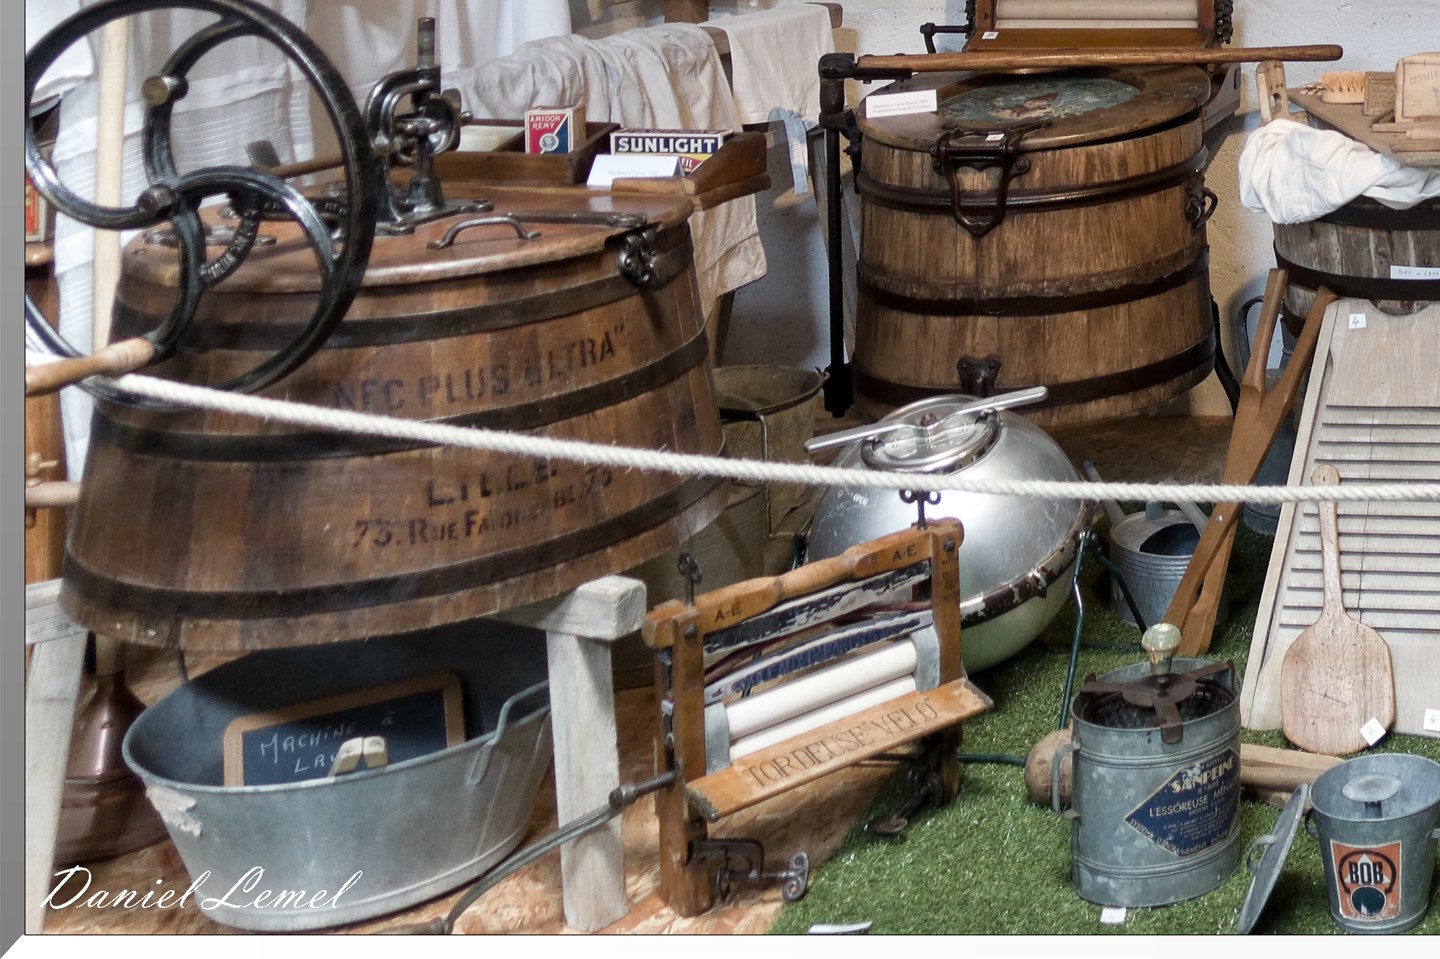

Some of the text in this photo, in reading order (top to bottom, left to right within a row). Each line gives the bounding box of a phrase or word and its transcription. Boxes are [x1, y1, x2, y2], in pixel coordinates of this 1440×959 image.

[530, 115, 561, 124] AMIDON
[532, 122, 555, 130] REMY
[617, 138, 716, 153] SUNLIGHT
[418, 363, 510, 409] PLUS
[742, 726, 874, 788] TORDEUSE
[1348, 861, 1384, 886] BOB
